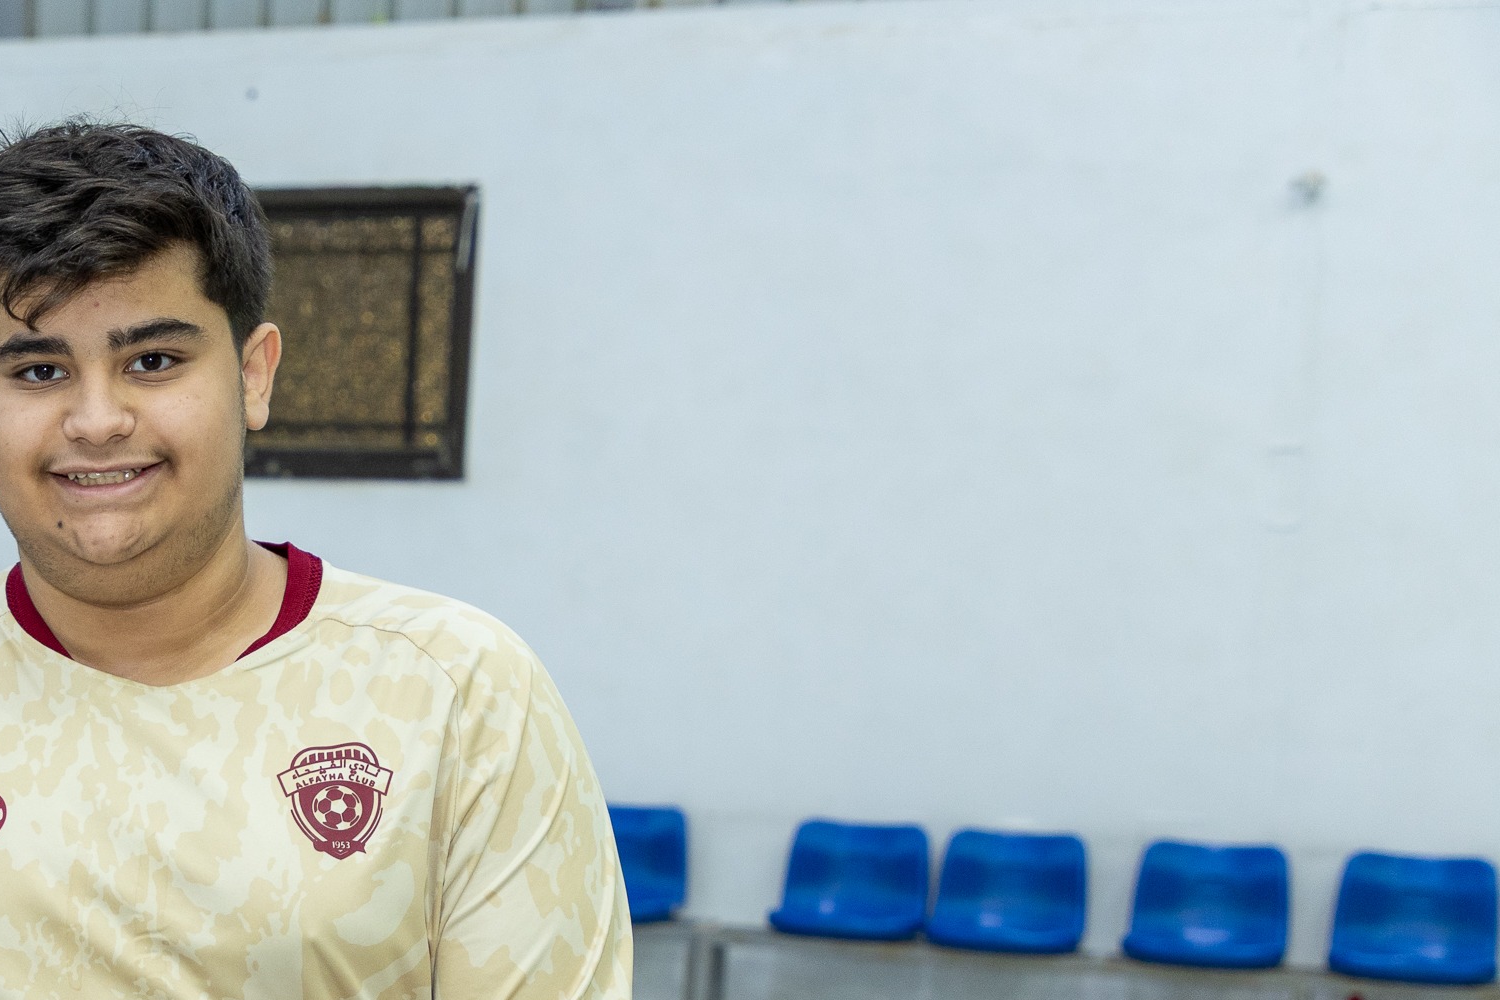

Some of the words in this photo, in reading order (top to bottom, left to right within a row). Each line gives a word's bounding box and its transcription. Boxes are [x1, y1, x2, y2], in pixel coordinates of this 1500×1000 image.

[349, 763, 380, 777] نادي
[295, 773, 344, 790] ALFAYHA
[348, 775, 375, 787] CLUB
[331, 841, 351, 849] 1953
